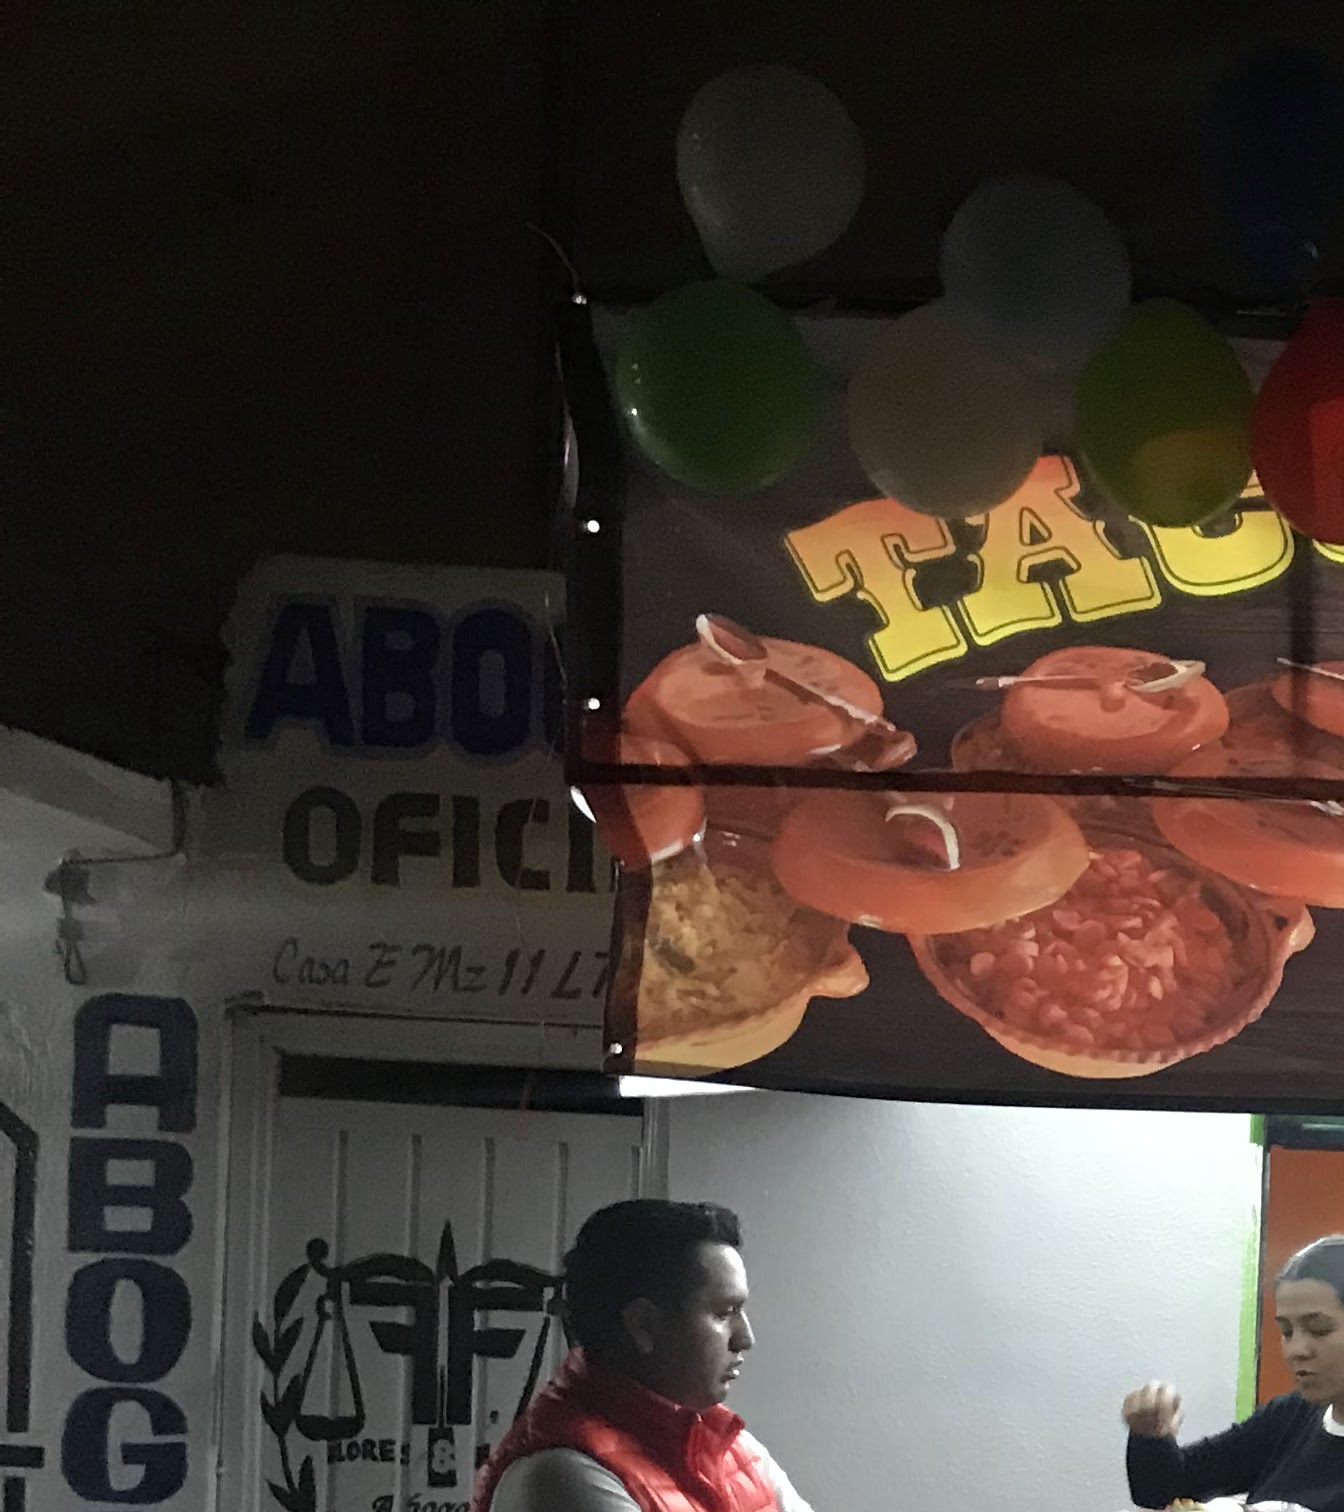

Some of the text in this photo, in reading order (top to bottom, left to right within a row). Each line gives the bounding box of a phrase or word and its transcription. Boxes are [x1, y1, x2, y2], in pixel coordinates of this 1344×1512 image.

[243, 600, 567, 758] ABO
[282, 786, 614, 894] OFICI
[272, 936, 350, 988] Casa
[410, 943, 487, 993] Mz
